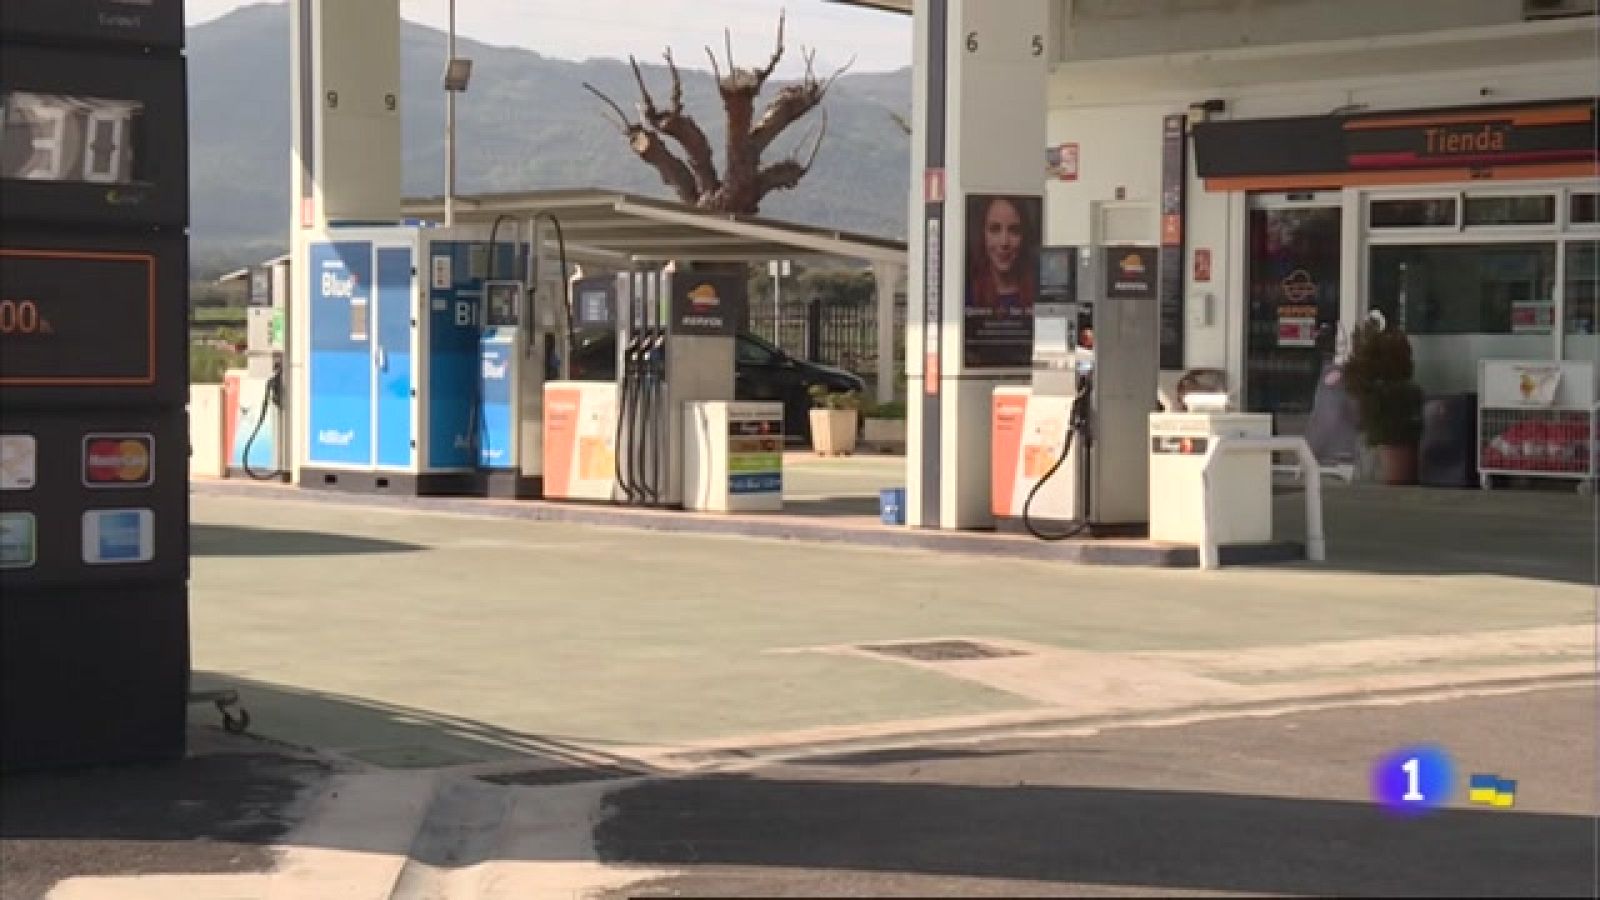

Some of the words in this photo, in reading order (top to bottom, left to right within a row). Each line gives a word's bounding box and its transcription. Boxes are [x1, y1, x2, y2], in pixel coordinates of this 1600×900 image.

[966, 31, 979, 53] 6
[1031, 34, 1044, 56] 5
[326, 90, 339, 109] 9
[384, 94, 397, 112] 9
[1423, 124, 1505, 154] Tienda
